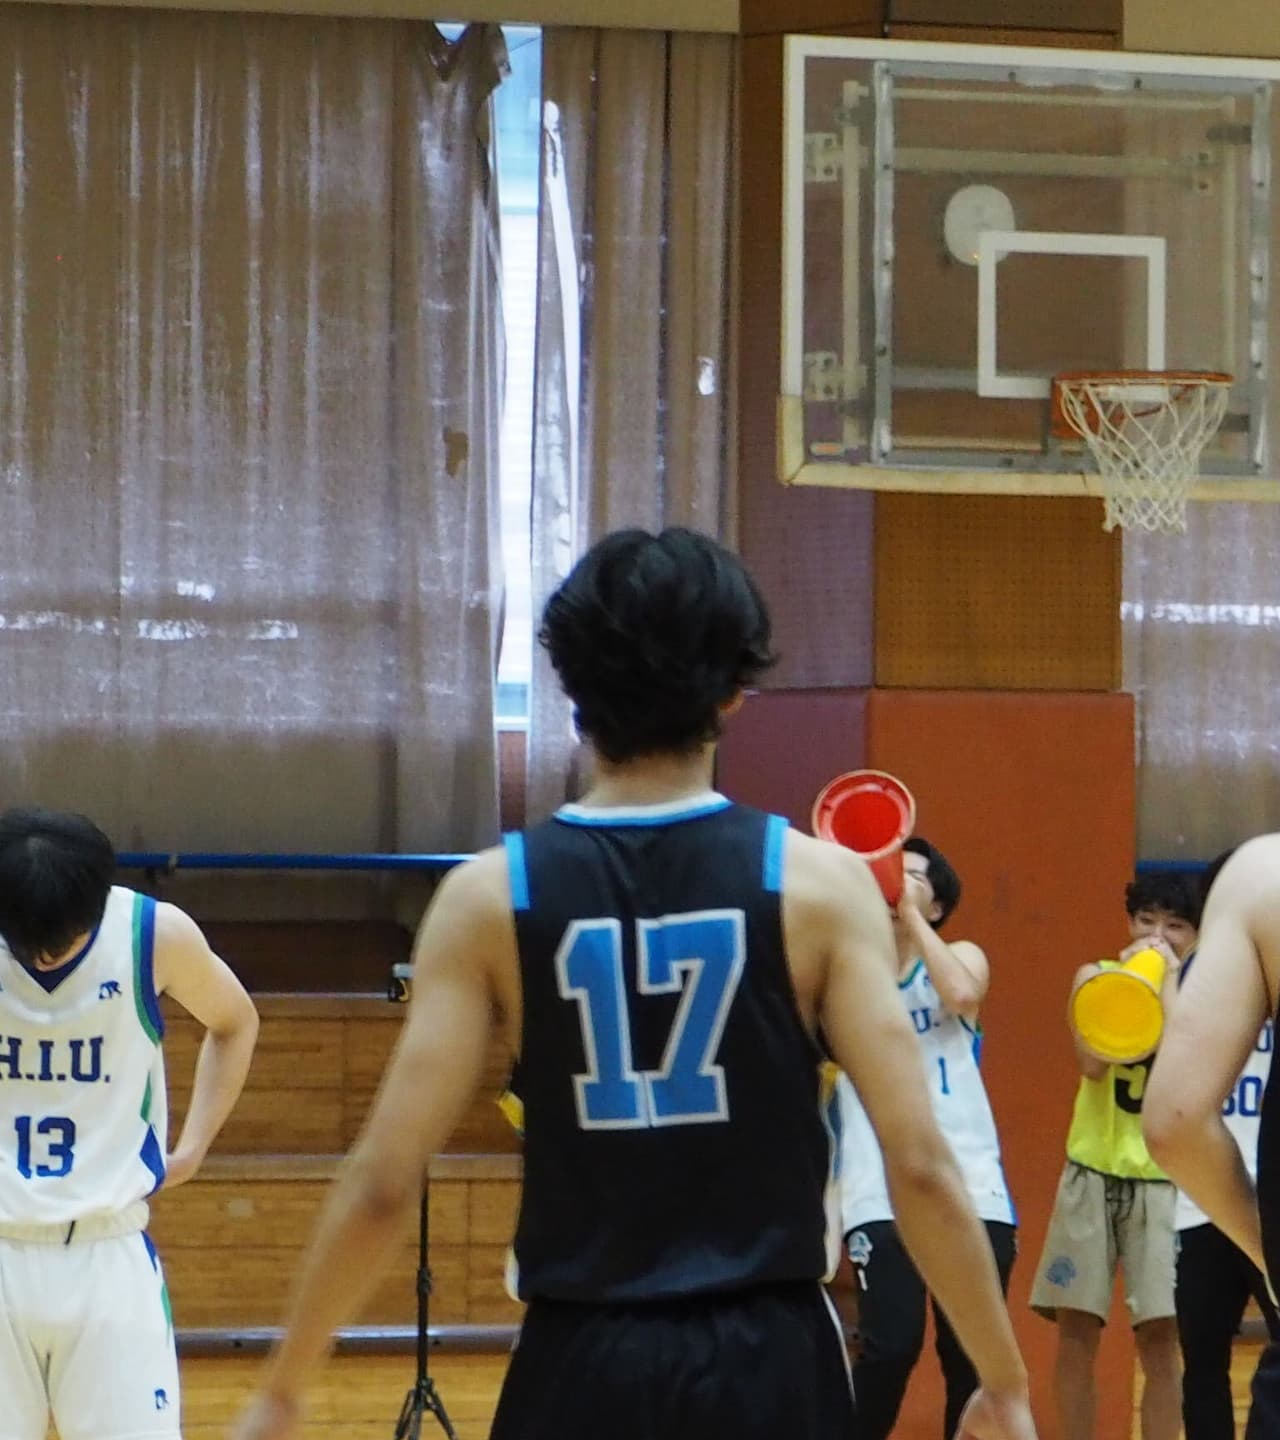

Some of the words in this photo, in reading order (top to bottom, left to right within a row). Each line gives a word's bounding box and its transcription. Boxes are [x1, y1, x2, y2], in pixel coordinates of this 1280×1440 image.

[554, 908, 747, 1130] 17
[0, 1035, 111, 1083] H.I.U.
[14, 1115, 77, 1179] 13
